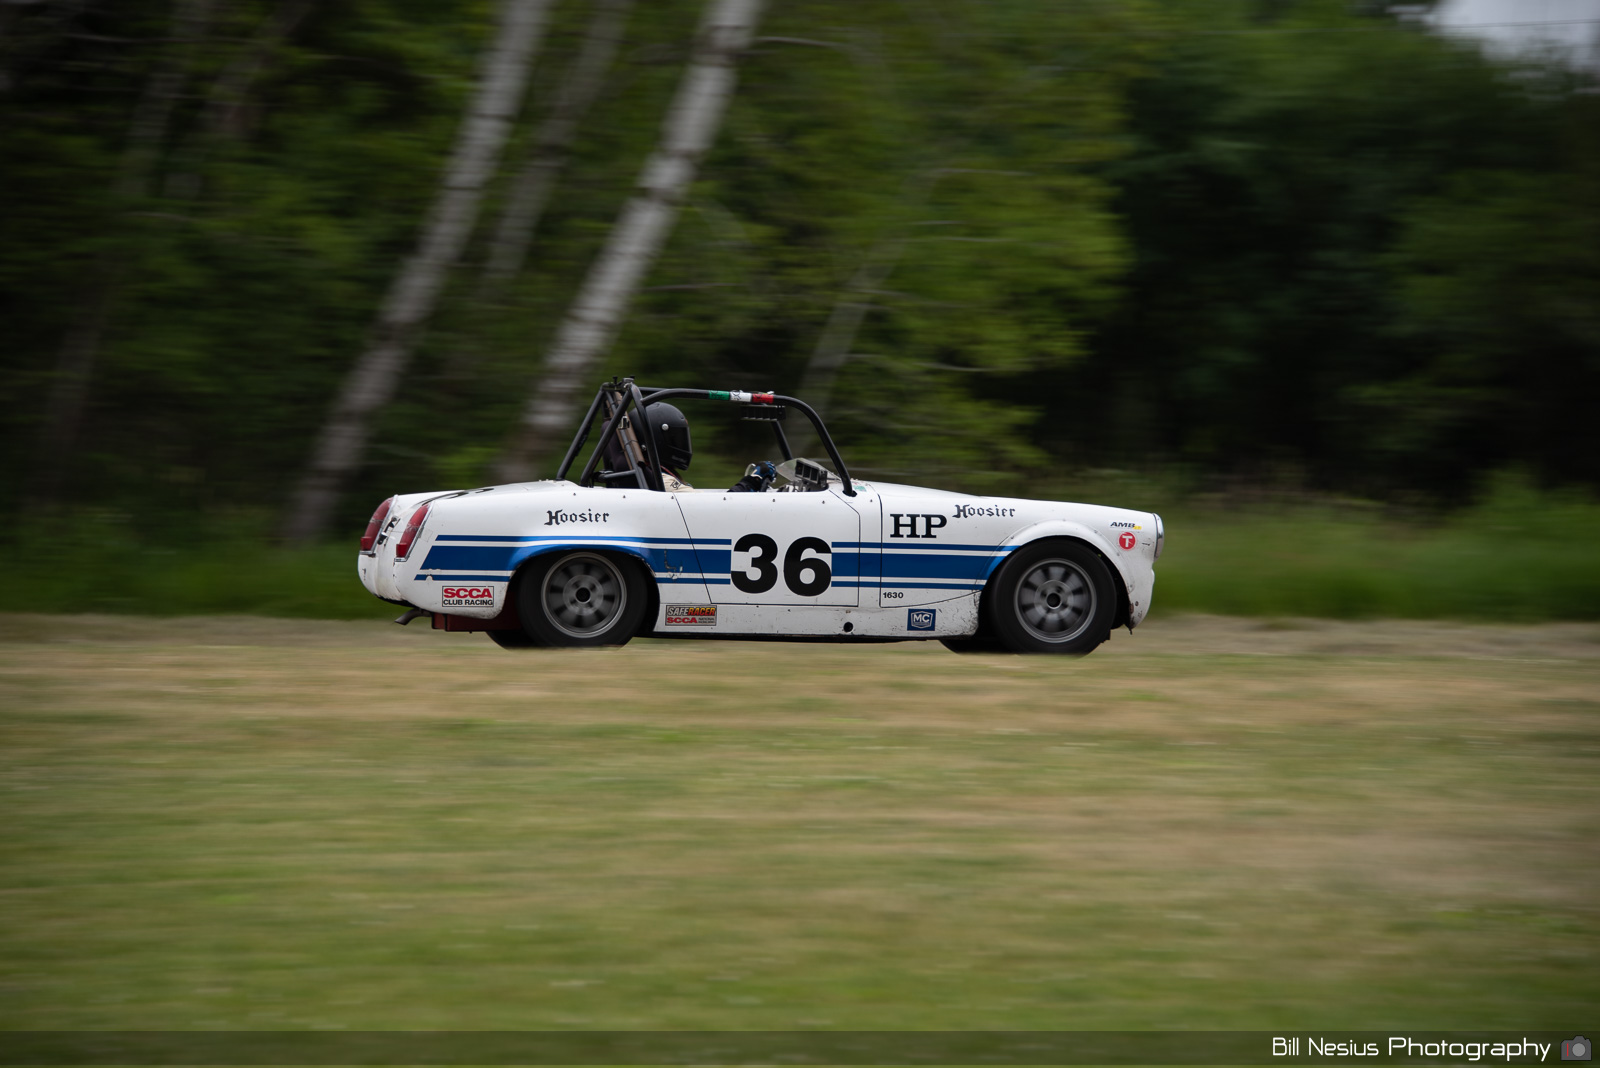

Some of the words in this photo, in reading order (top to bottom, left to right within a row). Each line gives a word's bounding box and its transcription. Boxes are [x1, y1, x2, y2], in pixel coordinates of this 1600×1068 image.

[544, 508, 610, 525] Hoosier
[952, 504, 1015, 518] Hoosier
[890, 513, 948, 538] HP
[730, 533, 832, 597] 36
[443, 587, 493, 599] SCCA
[883, 591, 904, 599] 1630
[666, 616, 698, 624] SCCA
[913, 613, 930, 622] MC
